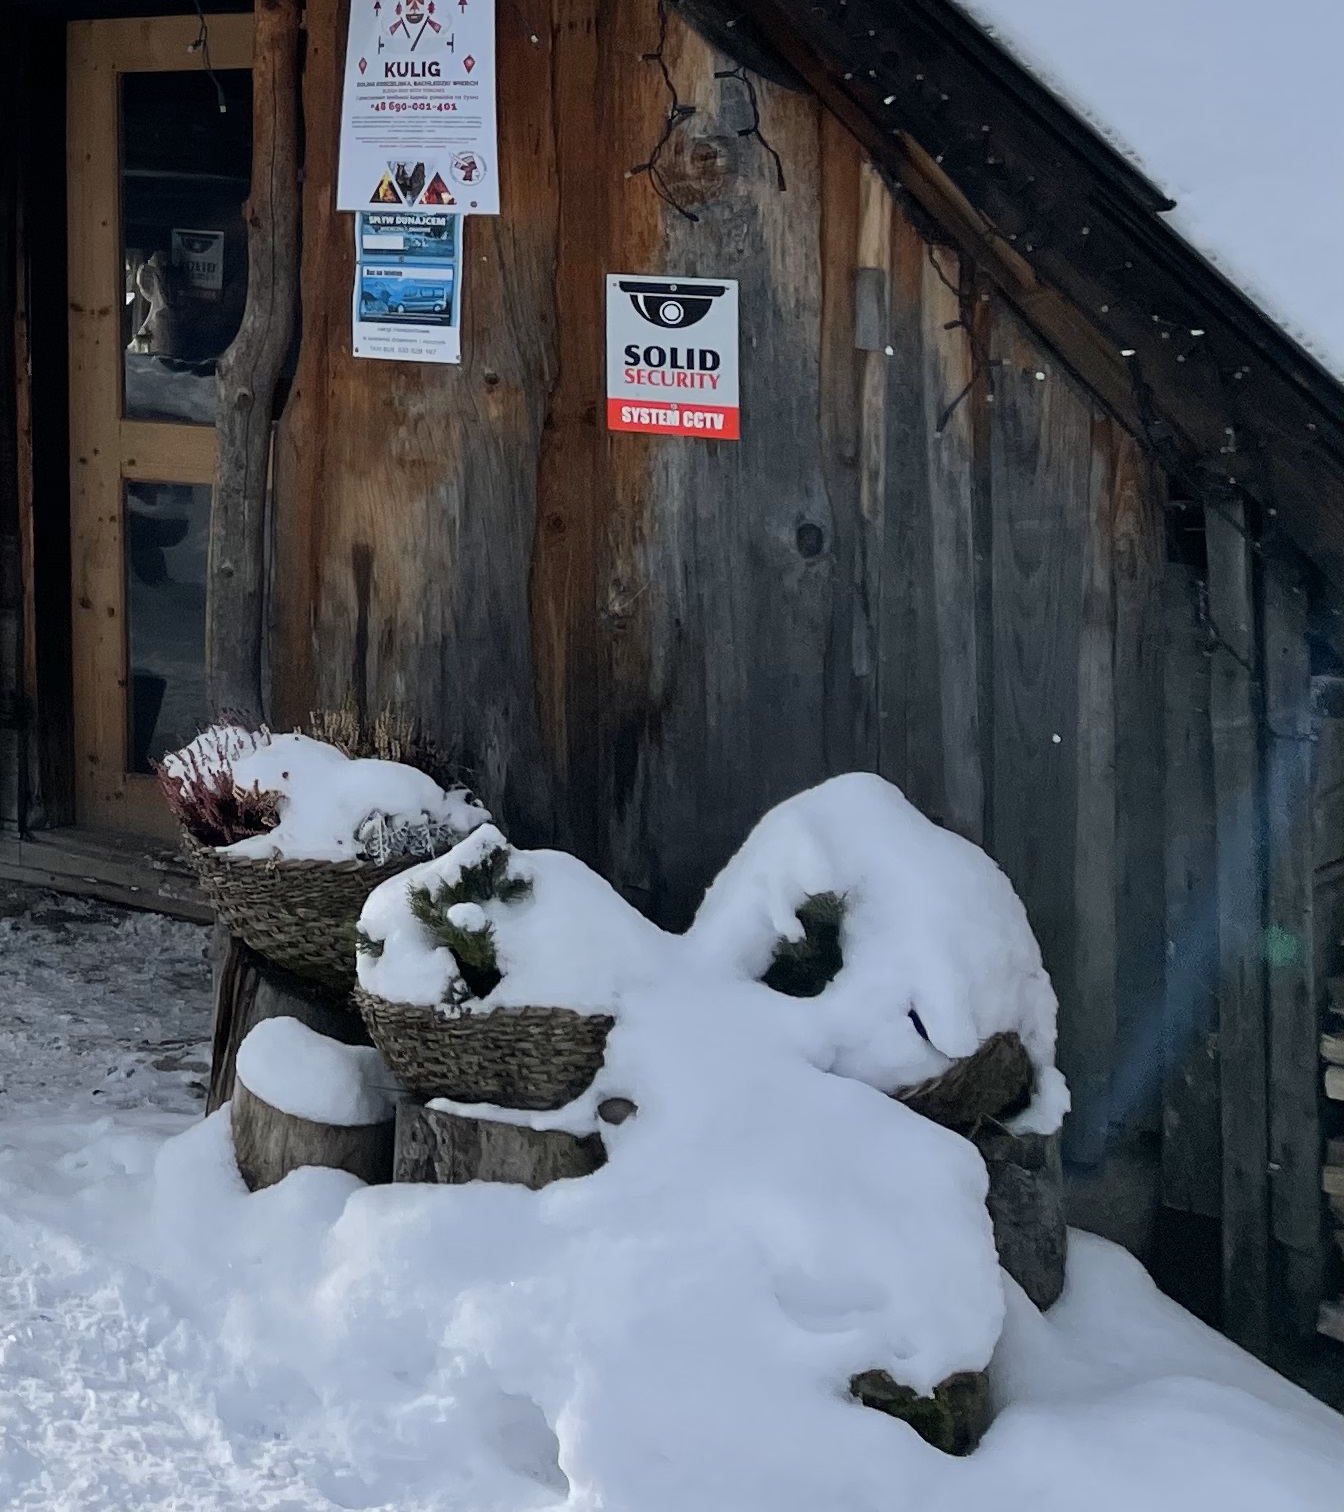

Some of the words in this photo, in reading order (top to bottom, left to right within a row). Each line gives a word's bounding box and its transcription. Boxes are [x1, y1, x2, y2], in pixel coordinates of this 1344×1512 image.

[384, 61, 441, 78] KULIG
[624, 344, 721, 372] SOLID
[624, 368, 721, 390] SECURITY
[621, 406, 680, 427] SYSTEM
[683, 410, 725, 430] CCTV
